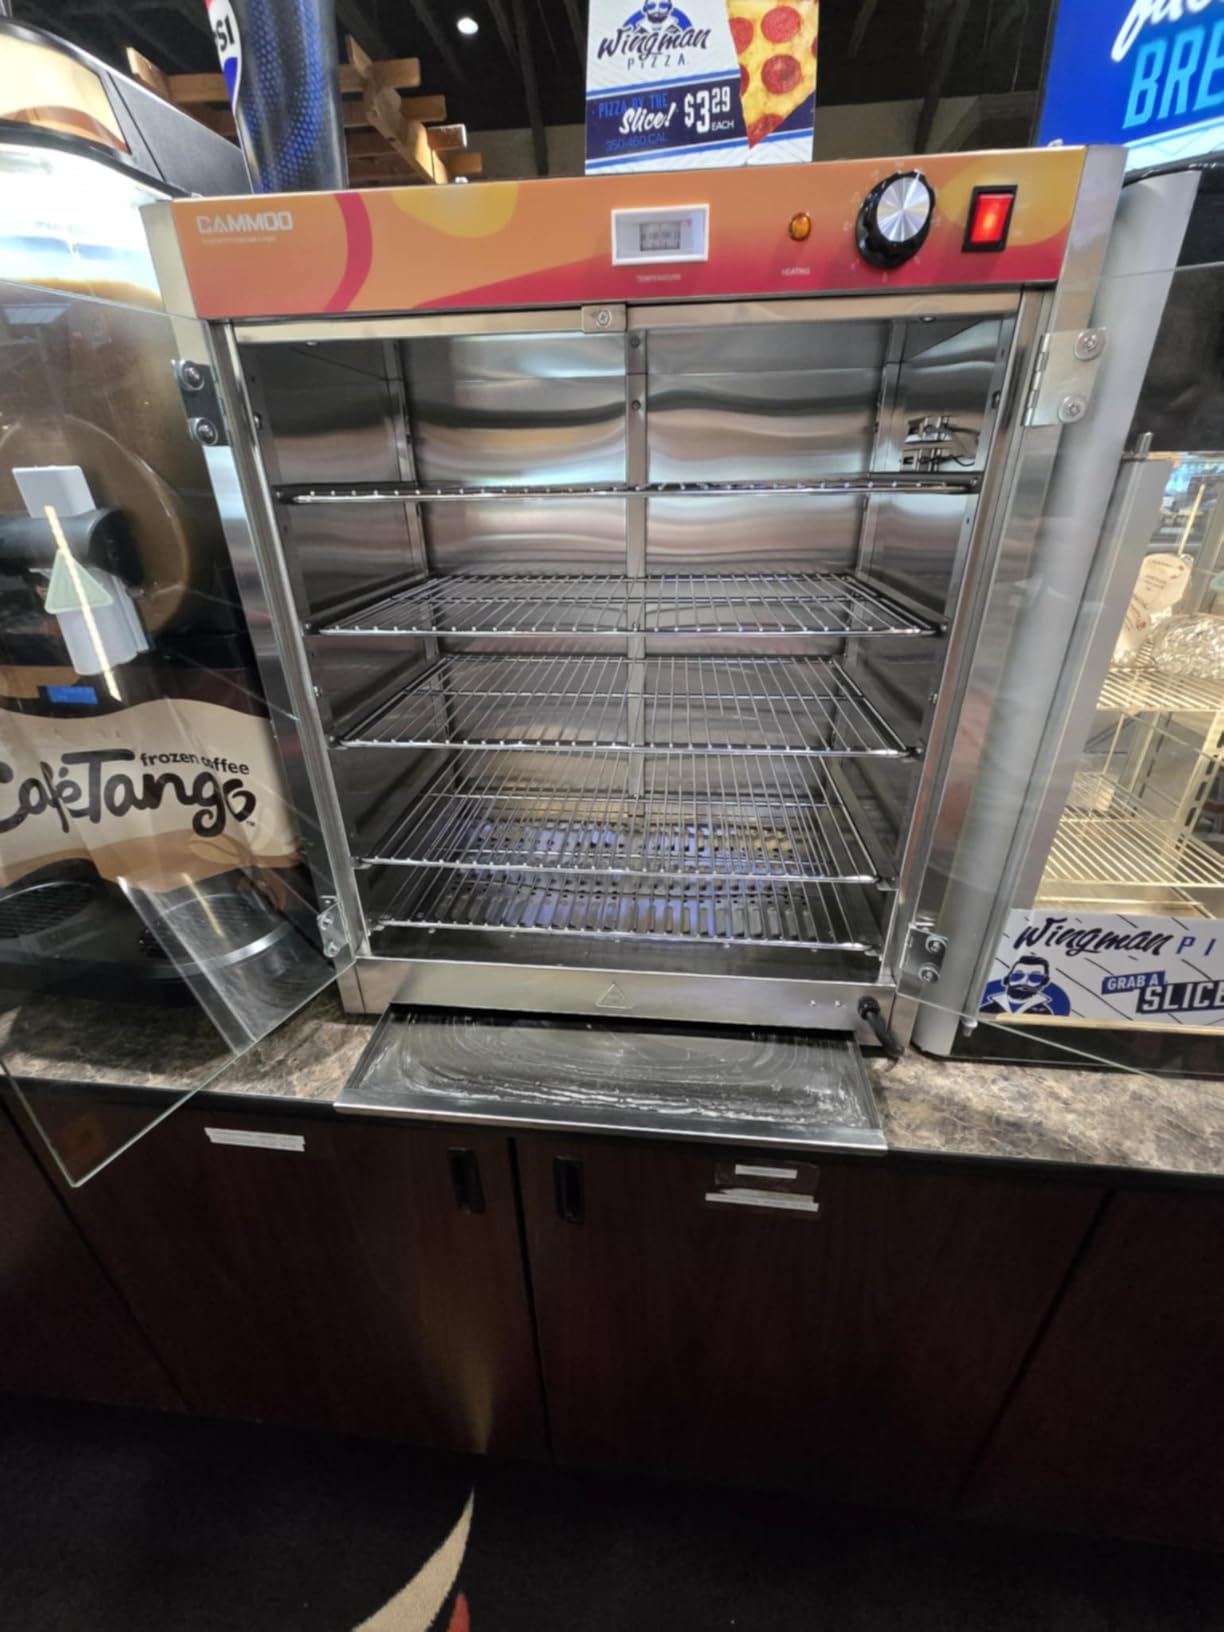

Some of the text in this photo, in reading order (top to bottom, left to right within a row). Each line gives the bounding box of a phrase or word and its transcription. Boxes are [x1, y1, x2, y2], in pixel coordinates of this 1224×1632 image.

[212, 14, 235, 52] SI
[597, 26, 711, 60] Wingman
[627, 54, 686, 71] PIZZA
[1121, 20, 1224, 131] BRE
[649, 91, 669, 110] THE
[618, 101, 677, 135] Slice!
[711, 119, 735, 132] EACH
[140, 752, 200, 767] frozen
[1013, 917, 1174, 957] Wingman
[1107, 973, 1160, 992] GRAB A
